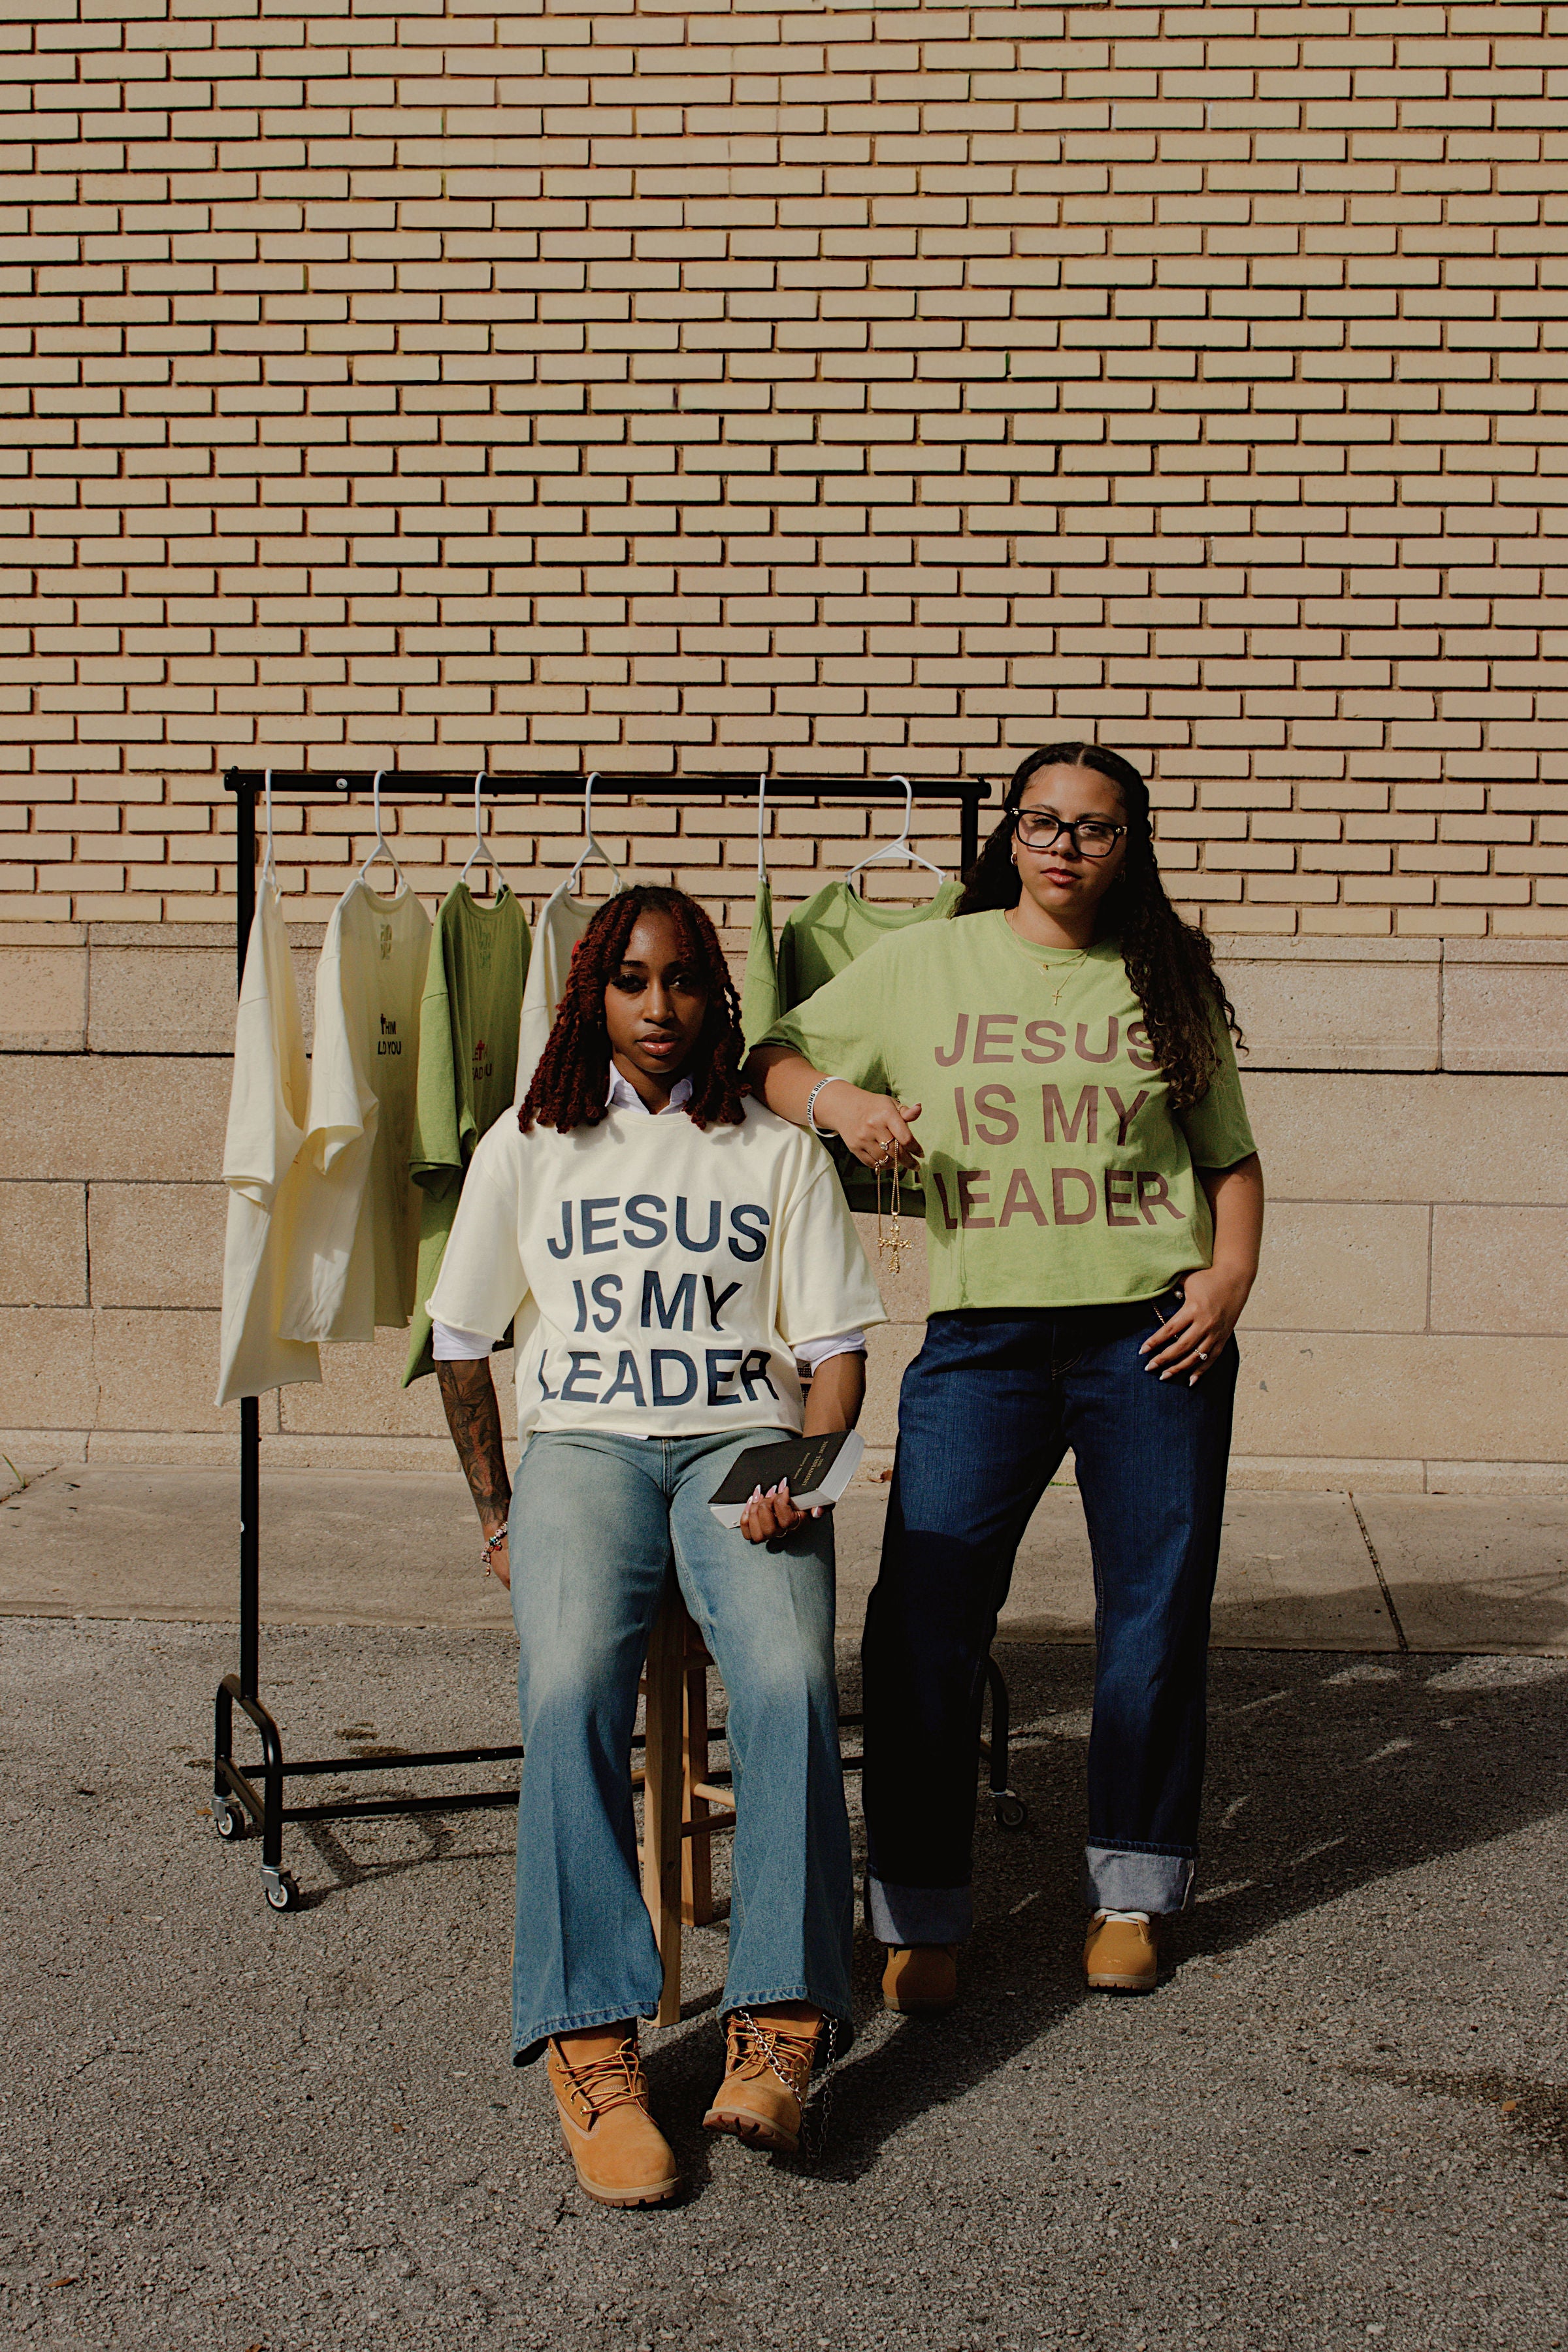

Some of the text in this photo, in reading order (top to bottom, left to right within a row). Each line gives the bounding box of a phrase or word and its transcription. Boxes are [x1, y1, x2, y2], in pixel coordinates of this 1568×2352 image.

[387, 1041, 401, 1055] YOU
[934, 1013, 1161, 1071] JESUS
[814, 1079, 828, 1092] GOOD
[954, 1084, 1150, 1146] IS MY
[547, 1194, 770, 1262] JESUS
[933, 1168, 1186, 1230] LEADER
[572, 1270, 743, 1333] IS MY
[538, 1349, 779, 1407] LEADER
